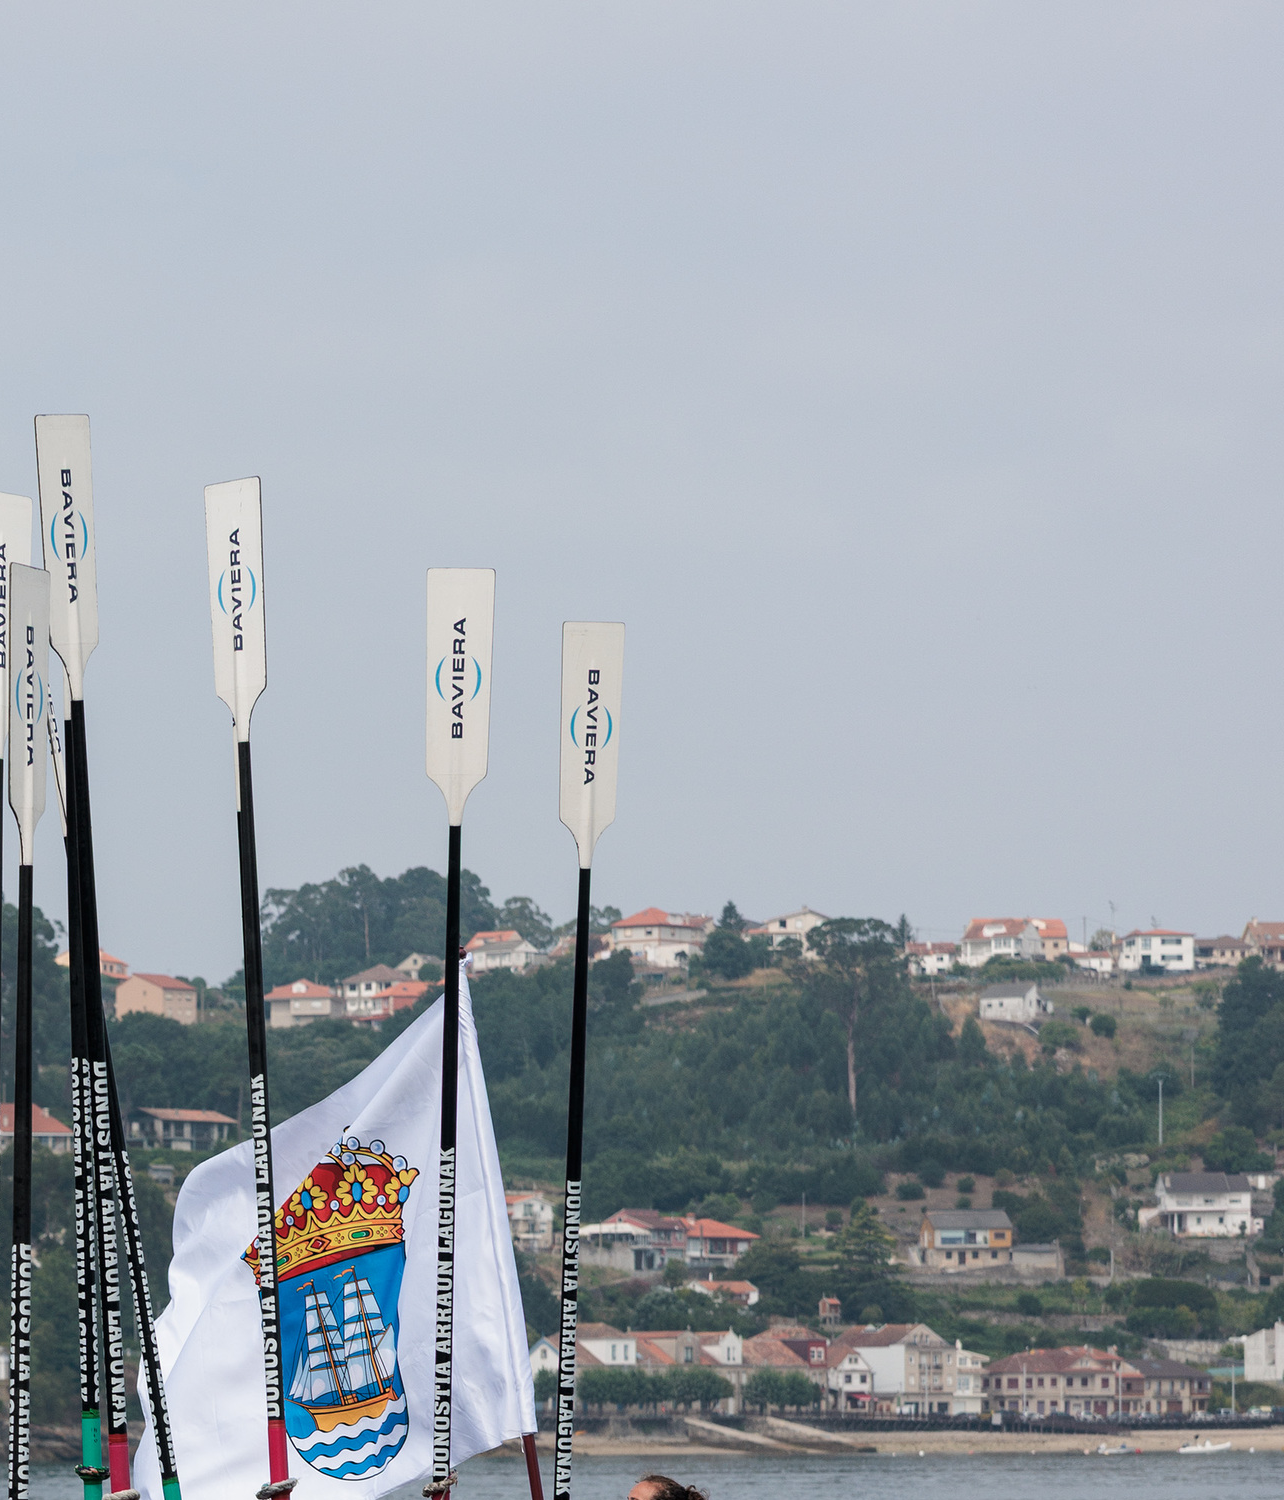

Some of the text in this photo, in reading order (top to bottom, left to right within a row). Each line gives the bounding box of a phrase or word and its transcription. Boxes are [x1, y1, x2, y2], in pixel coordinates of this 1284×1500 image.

[59, 468, 78, 605] BAVIERA
[229, 527, 242, 652] BAVIERA
[26, 625, 35, 767] BAVIERA
[451, 617, 466, 739] BAVIERA
[583, 669, 600, 785] BAVIERA
[93, 1061, 127, 1428] DONOSTIA ARRAUN LAGUNAK
[251, 1073, 281, 1418] DONOSTIA ARRAUN LAGUNAK
[433, 1147, 455, 1477] DONOSTIA ARRAUN LAGUNAK
[555, 1180, 581, 1496] DONOSTIA ARRAUN LAGUNAK
